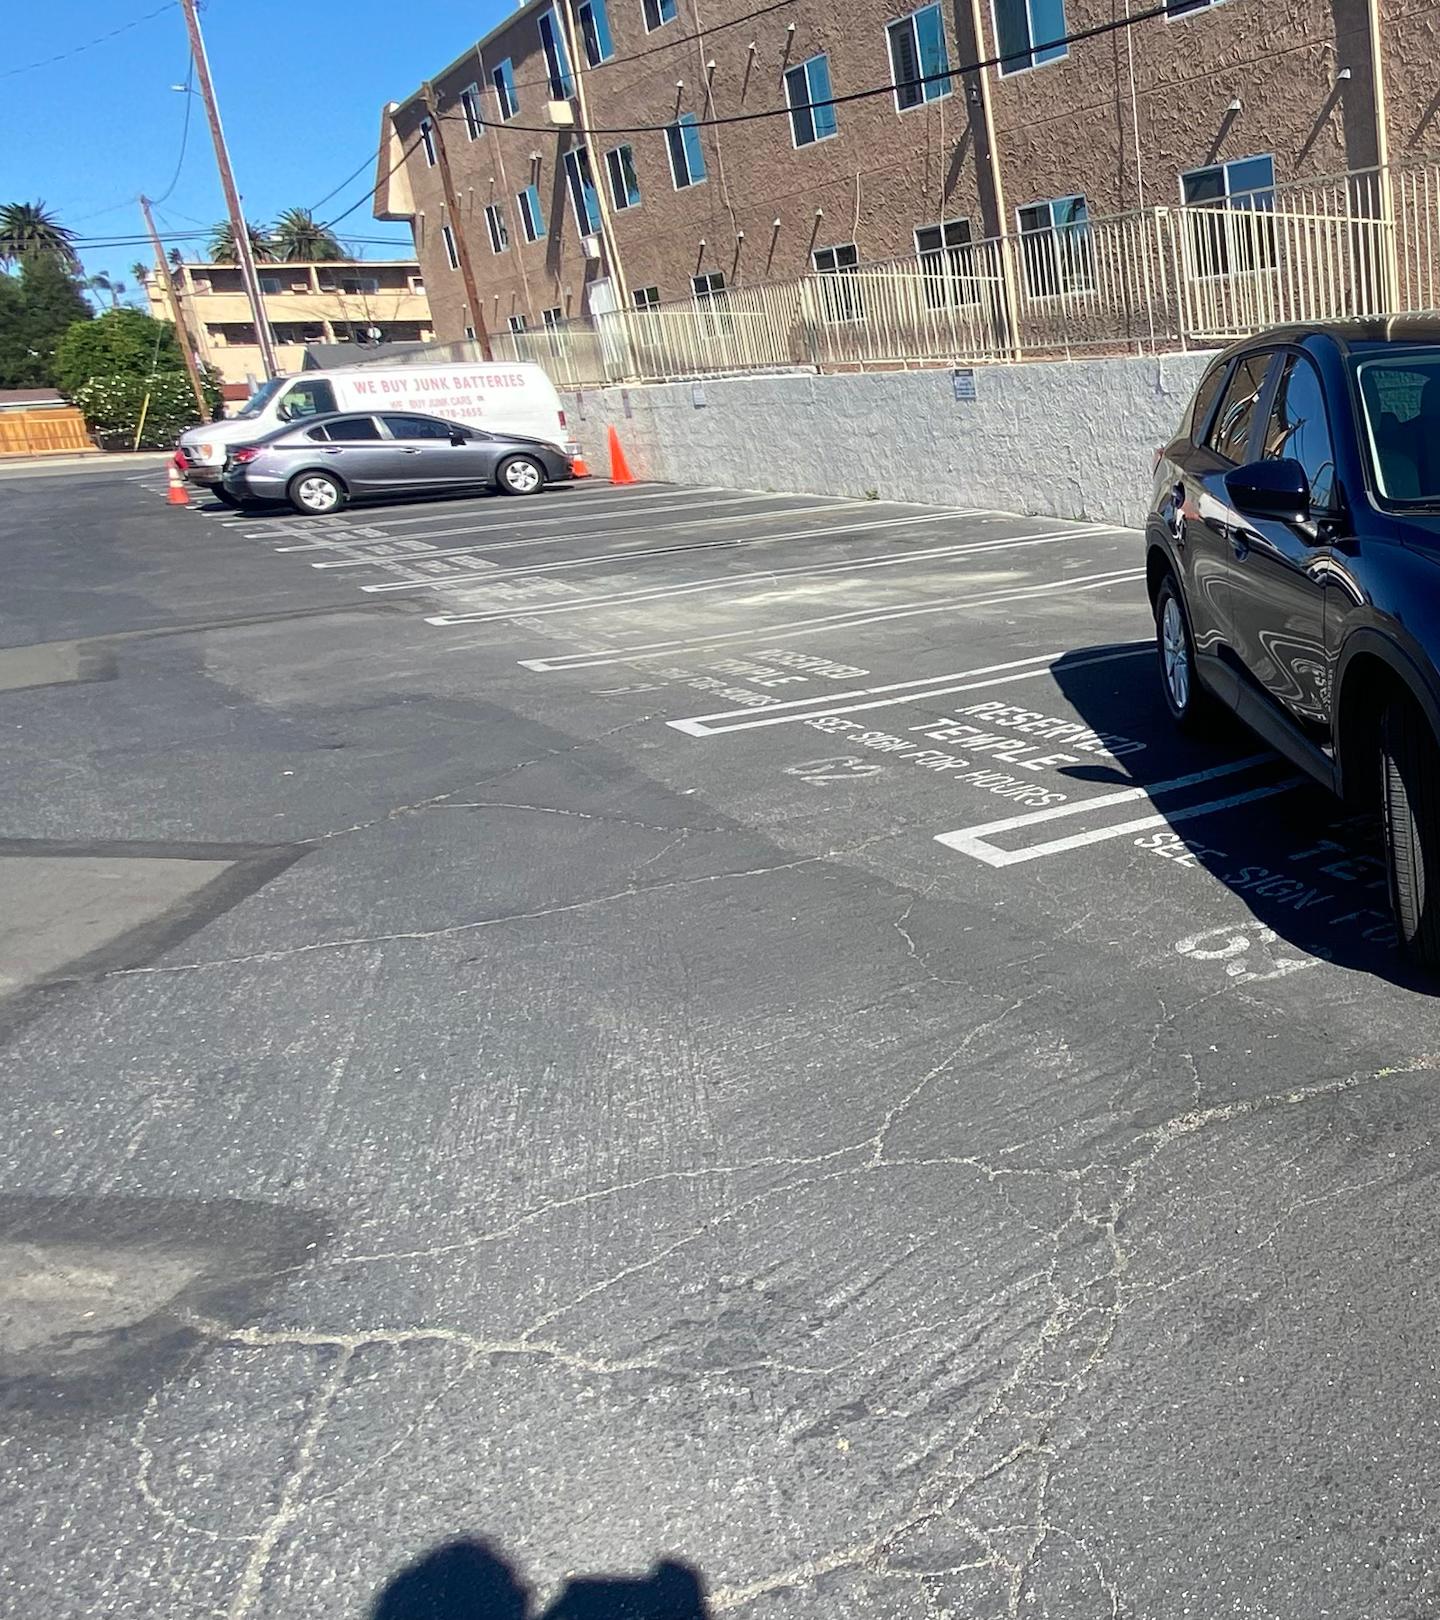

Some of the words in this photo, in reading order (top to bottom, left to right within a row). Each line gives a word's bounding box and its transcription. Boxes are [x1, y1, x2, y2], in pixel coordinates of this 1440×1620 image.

[353, 380, 377, 394] WE
[381, 378, 408, 393] BUY
[415, 377, 450, 392] JUNK
[453, 374, 526, 390] BATTERIES
[390, 400, 403, 409] WE
[409, 399, 426, 409] BUY
[450, 395, 473, 405] CARS
[744, 649, 871, 679] RESERVED
[908, 717, 1081, 771] TEMPLE
[954, 701, 1148, 757] RESERVED
[803, 716, 865, 734] SEE
[847, 731, 918, 752] SIGN
[899, 750, 971, 772] FOR
[954, 769, 1068, 807] HOURS
[1134, 832, 1229, 868] SEE
